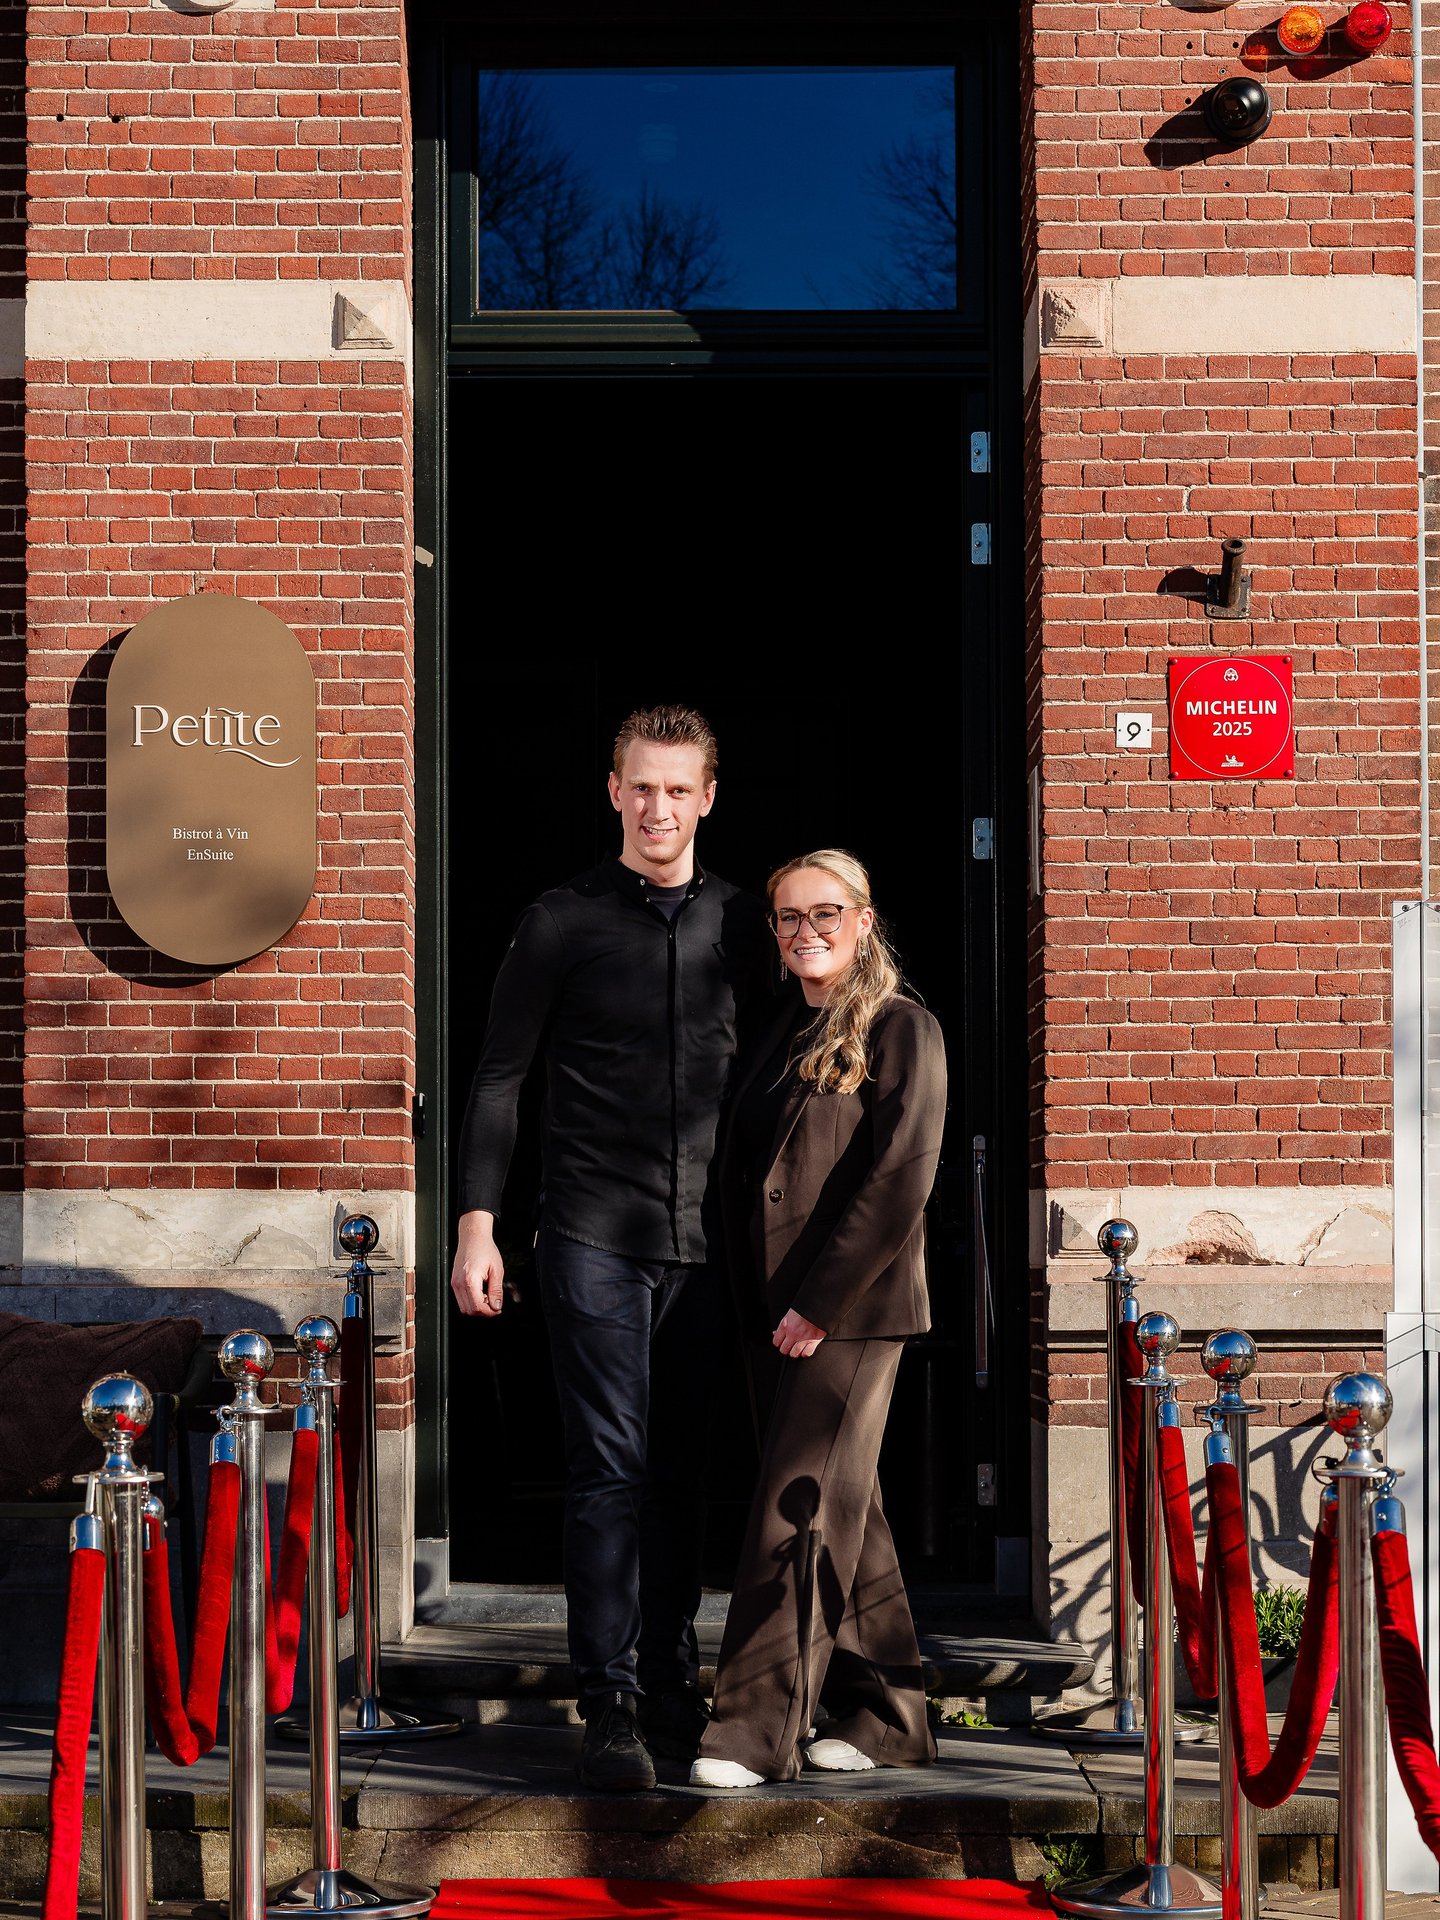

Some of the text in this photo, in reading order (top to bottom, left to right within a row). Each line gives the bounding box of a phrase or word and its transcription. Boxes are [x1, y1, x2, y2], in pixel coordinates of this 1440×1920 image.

[1186, 700, 1277, 716] MICHELIN
[1126, 721, 1142, 741] 9
[1212, 722, 1252, 736] 2025
[172, 827, 249, 840] Bistrot à Vin
[187, 849, 234, 861] EnSuite
